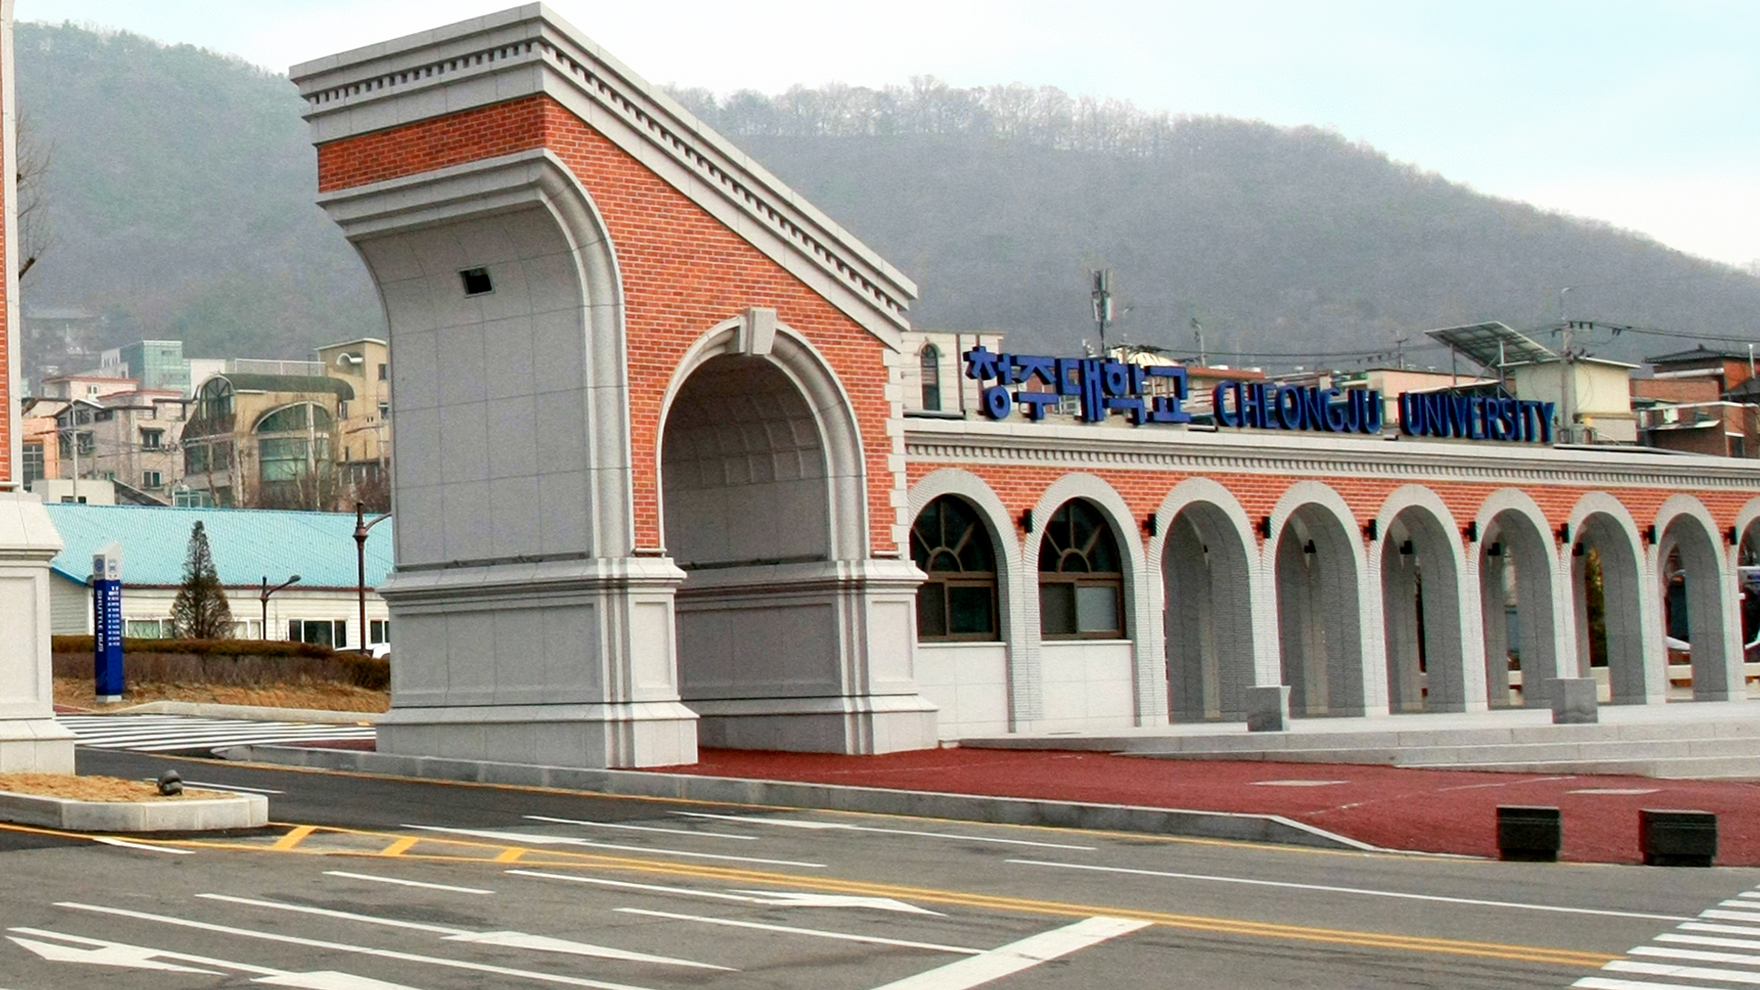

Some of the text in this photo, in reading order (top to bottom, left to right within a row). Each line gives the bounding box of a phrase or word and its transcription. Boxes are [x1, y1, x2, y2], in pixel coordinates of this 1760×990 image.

[963, 345, 1190, 425] 청주대학교
[1213, 380, 1555, 444] CHEONGJU UNIVERSITY
